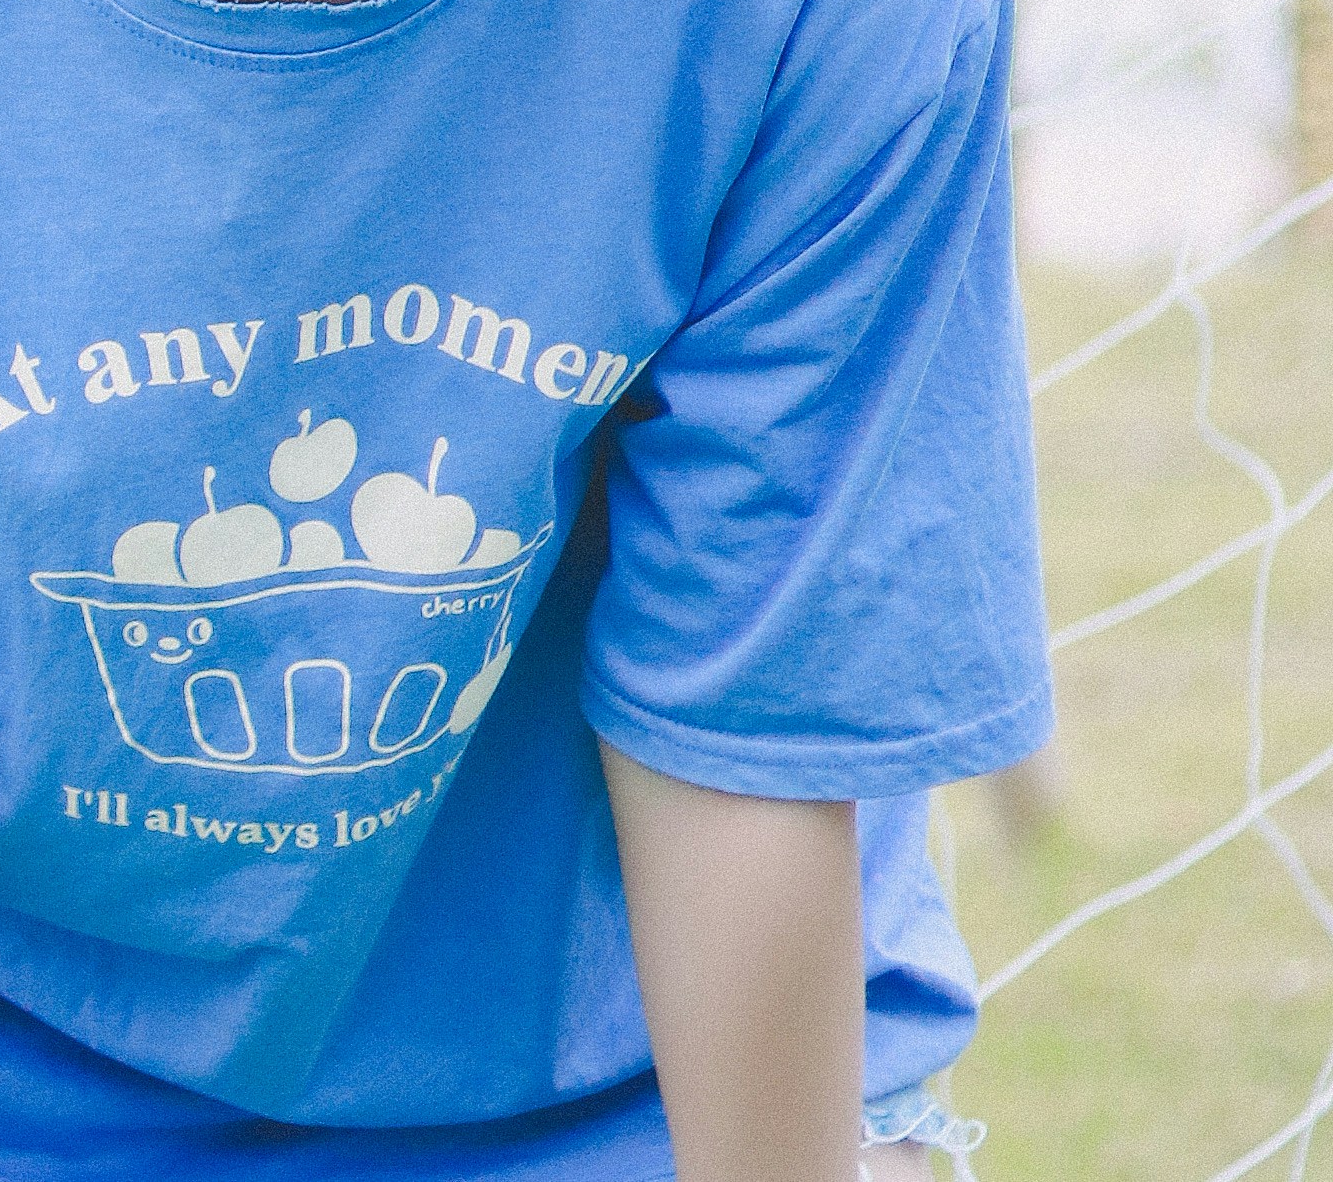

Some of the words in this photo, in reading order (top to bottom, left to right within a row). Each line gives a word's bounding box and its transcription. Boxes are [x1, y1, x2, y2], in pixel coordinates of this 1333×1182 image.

[76, 318, 267, 405] any
[420, 588, 507, 619] cherry
[62, 784, 131, 827] I'll
[144, 803, 319, 854] always
[333, 787, 422, 848] love
